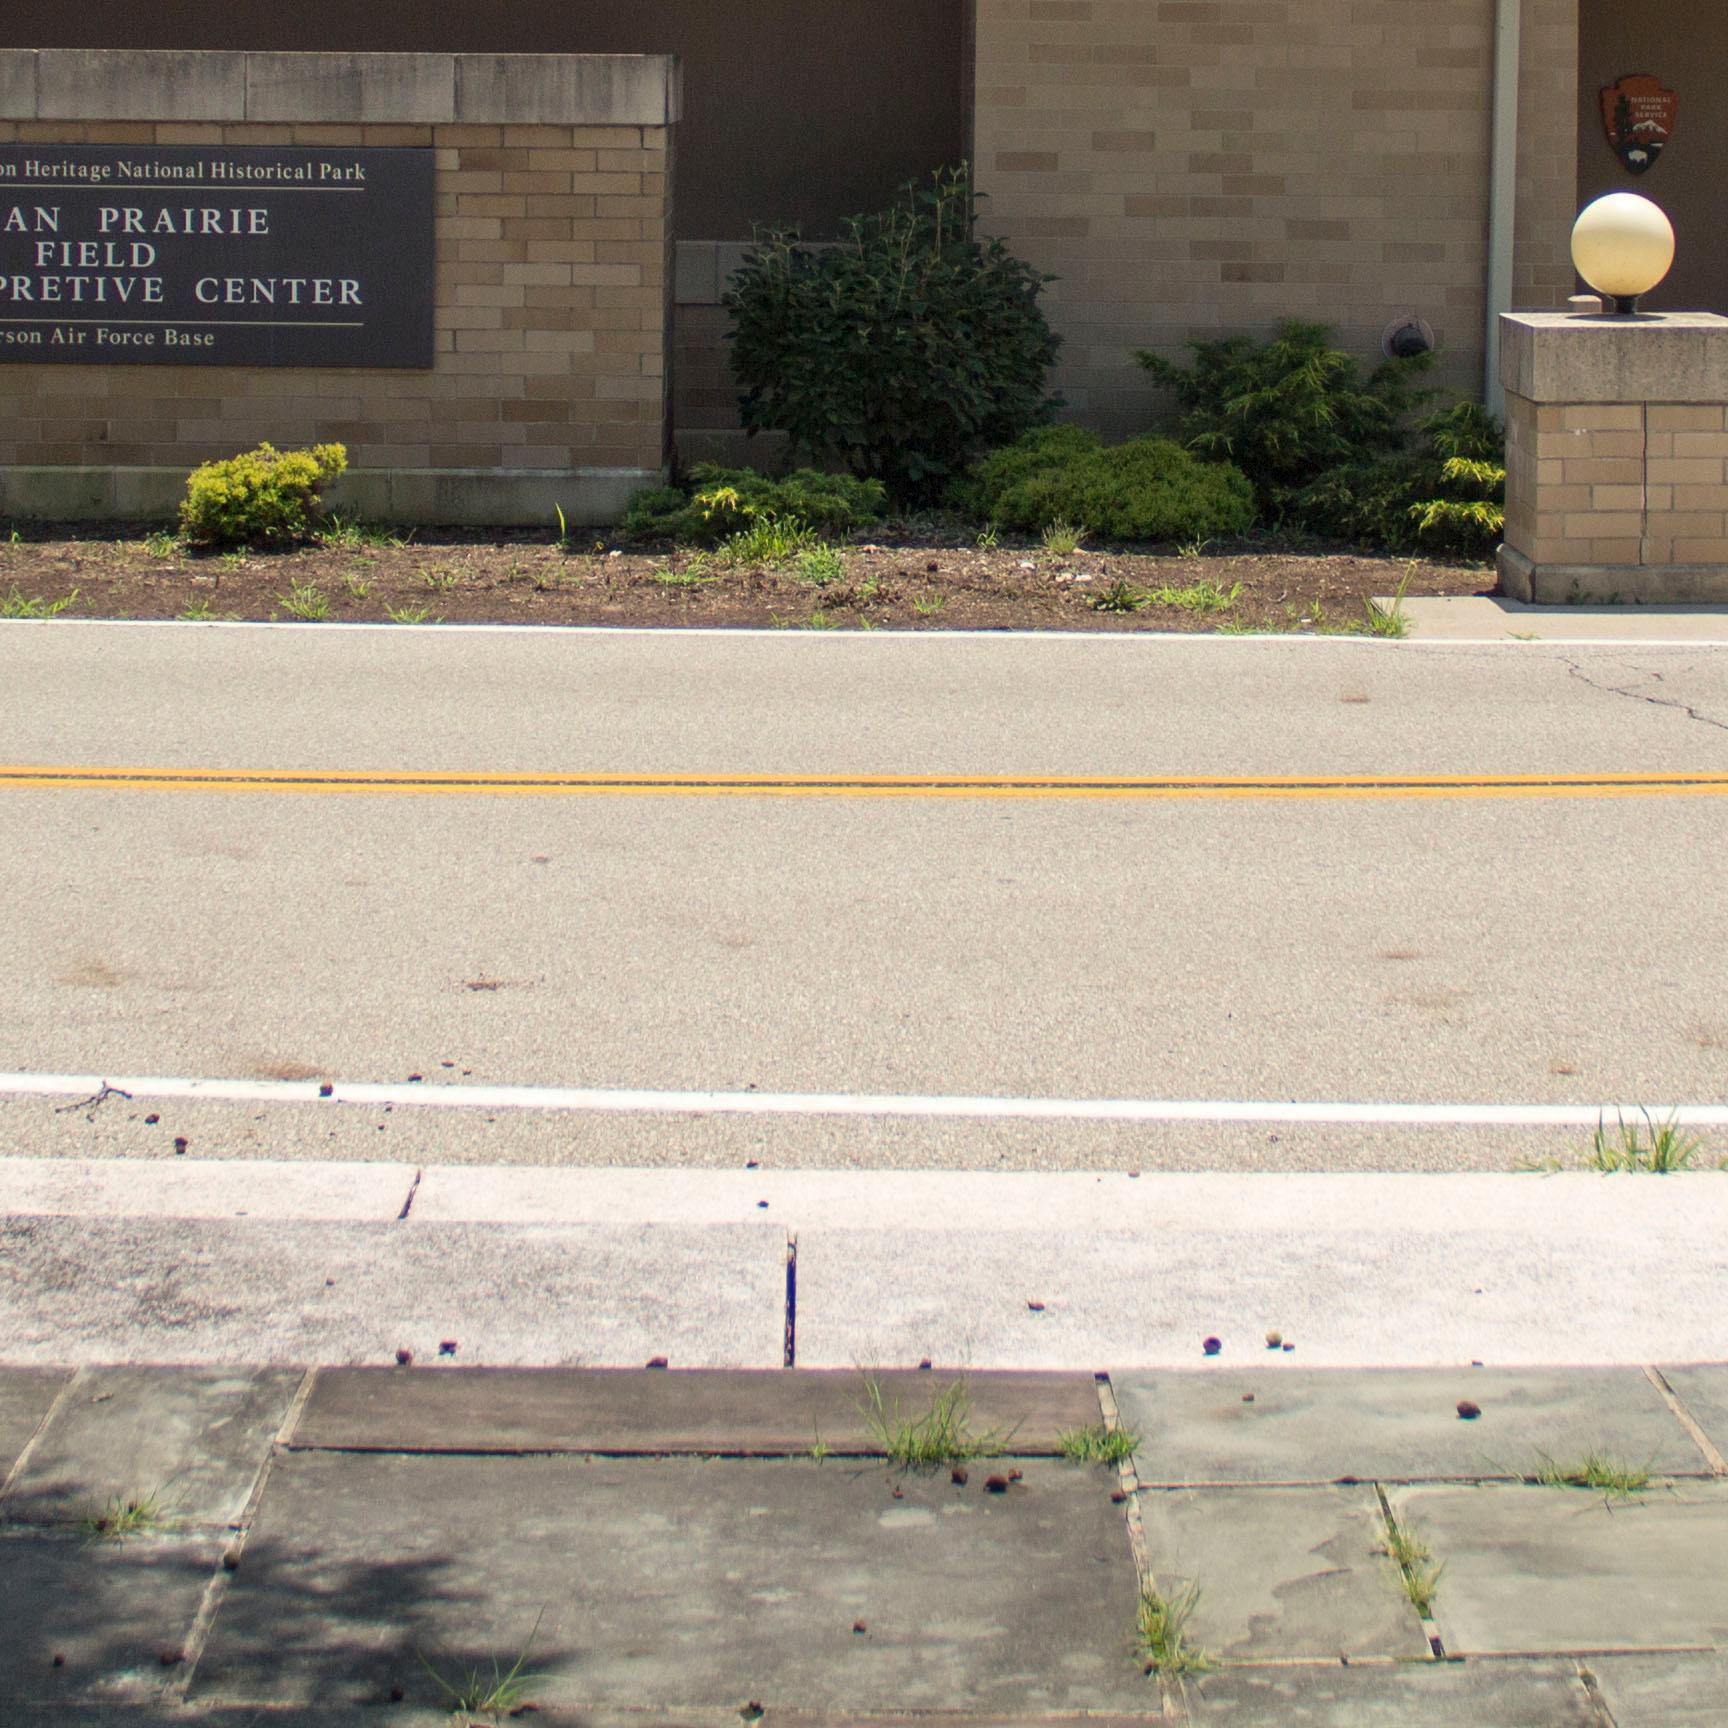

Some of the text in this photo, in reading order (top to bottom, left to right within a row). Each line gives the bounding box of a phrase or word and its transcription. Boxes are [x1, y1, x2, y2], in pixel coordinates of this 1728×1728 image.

[24, 160, 111, 181] Heritage
[118, 161, 203, 178] National
[211, 162, 312, 180] Historical
[320, 163, 366, 180] Park
[98, 207, 270, 234] PRAIRIE
[35, 241, 156, 268] FIELD
[195, 276, 363, 305] CENTER
[51, 328, 86, 345] Air
[97, 328, 155, 345] Force
[164, 329, 215, 346] Base
